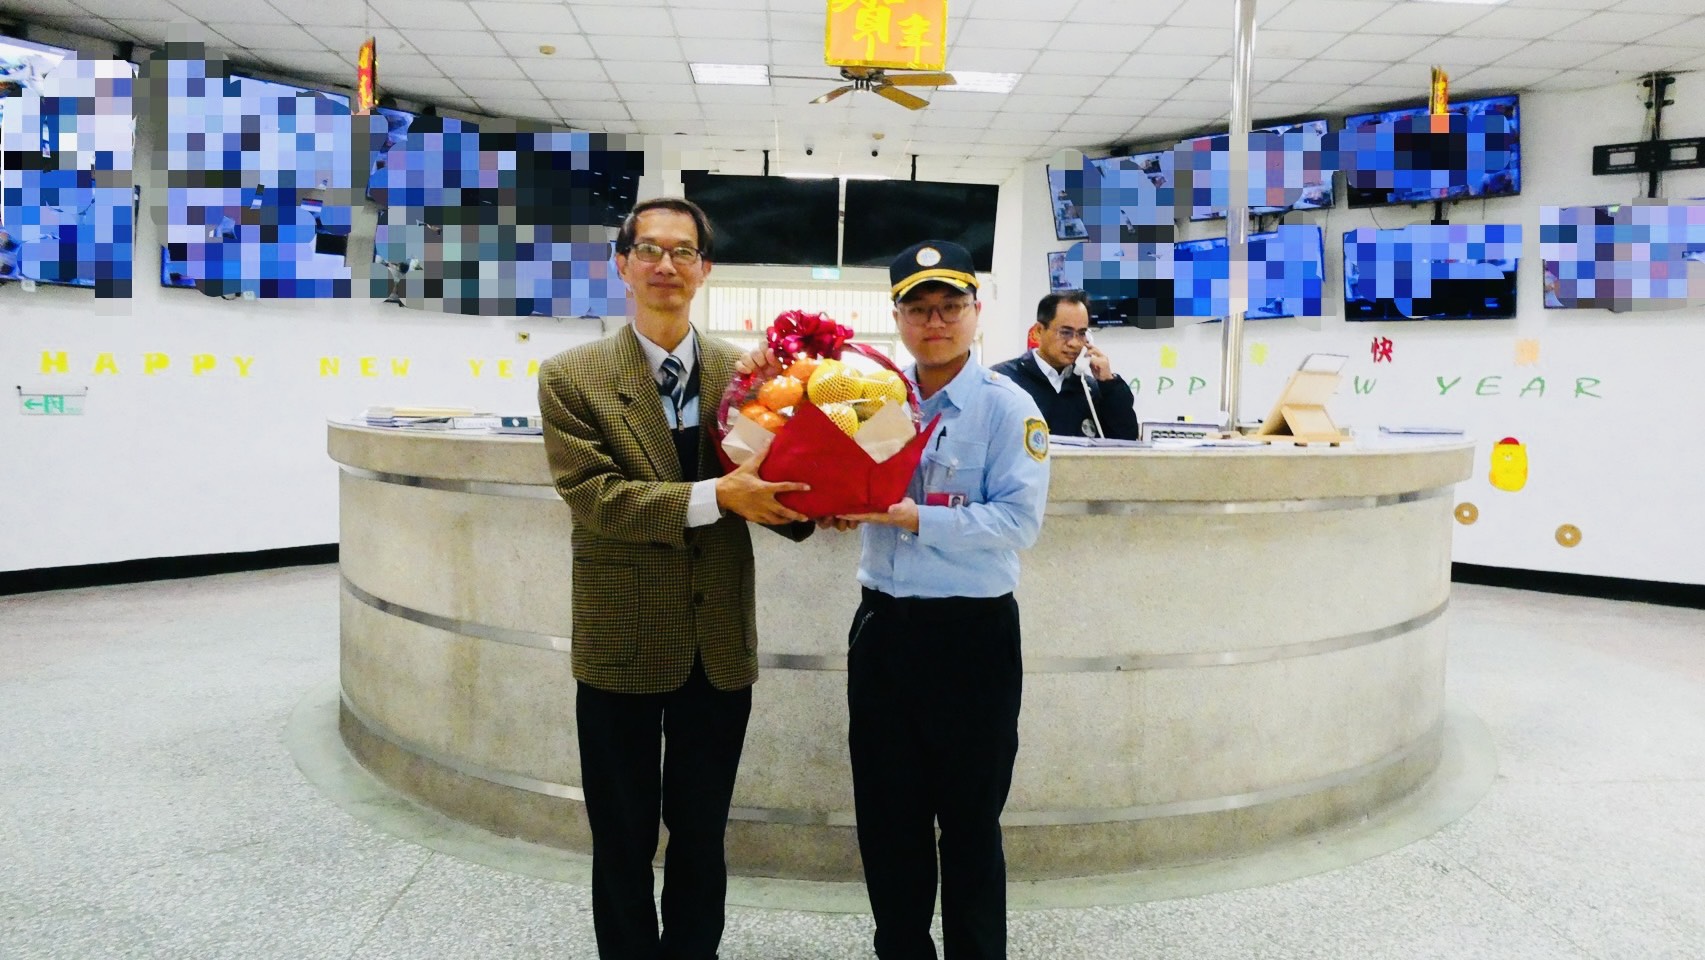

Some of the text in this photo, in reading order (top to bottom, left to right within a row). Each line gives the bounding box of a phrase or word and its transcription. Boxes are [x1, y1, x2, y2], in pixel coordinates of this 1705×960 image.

[1371, 336, 1393, 363] 快
[40, 350, 540, 378] HAPPY NEW YEA
[1129, 376, 1602, 398] APP YEAR
